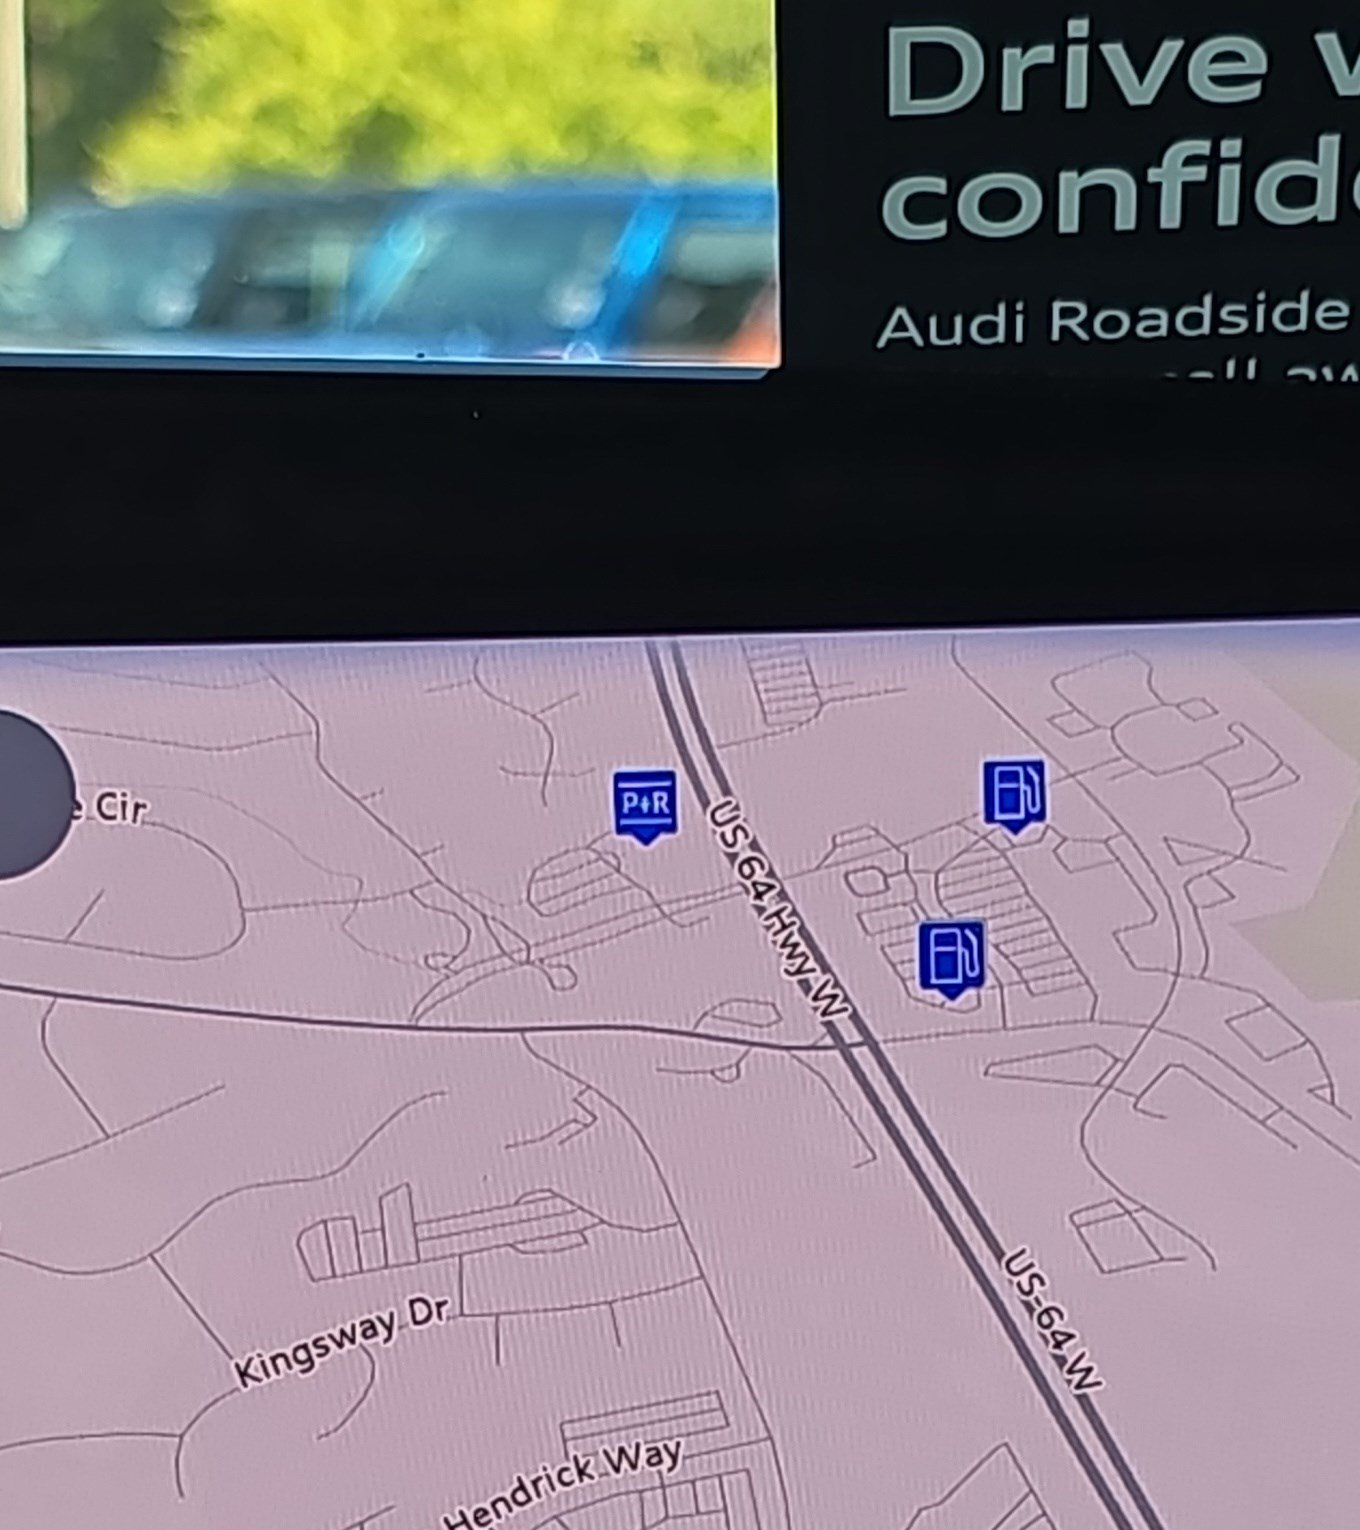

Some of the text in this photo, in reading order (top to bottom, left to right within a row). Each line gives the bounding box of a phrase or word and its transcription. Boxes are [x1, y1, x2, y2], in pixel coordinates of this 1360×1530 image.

[886, 18, 1268, 118] Drive
[875, 300, 1026, 350] Audi
[1050, 290, 1351, 342] Roadside
[96, 791, 147, 824] Cir
[710, 800, 849, 1018] US 64 Hwy W
[234, 1296, 449, 1390] Kingsway Dr
[1064, 1353, 1104, 1392] W
[603, 1440, 682, 1476] Way
